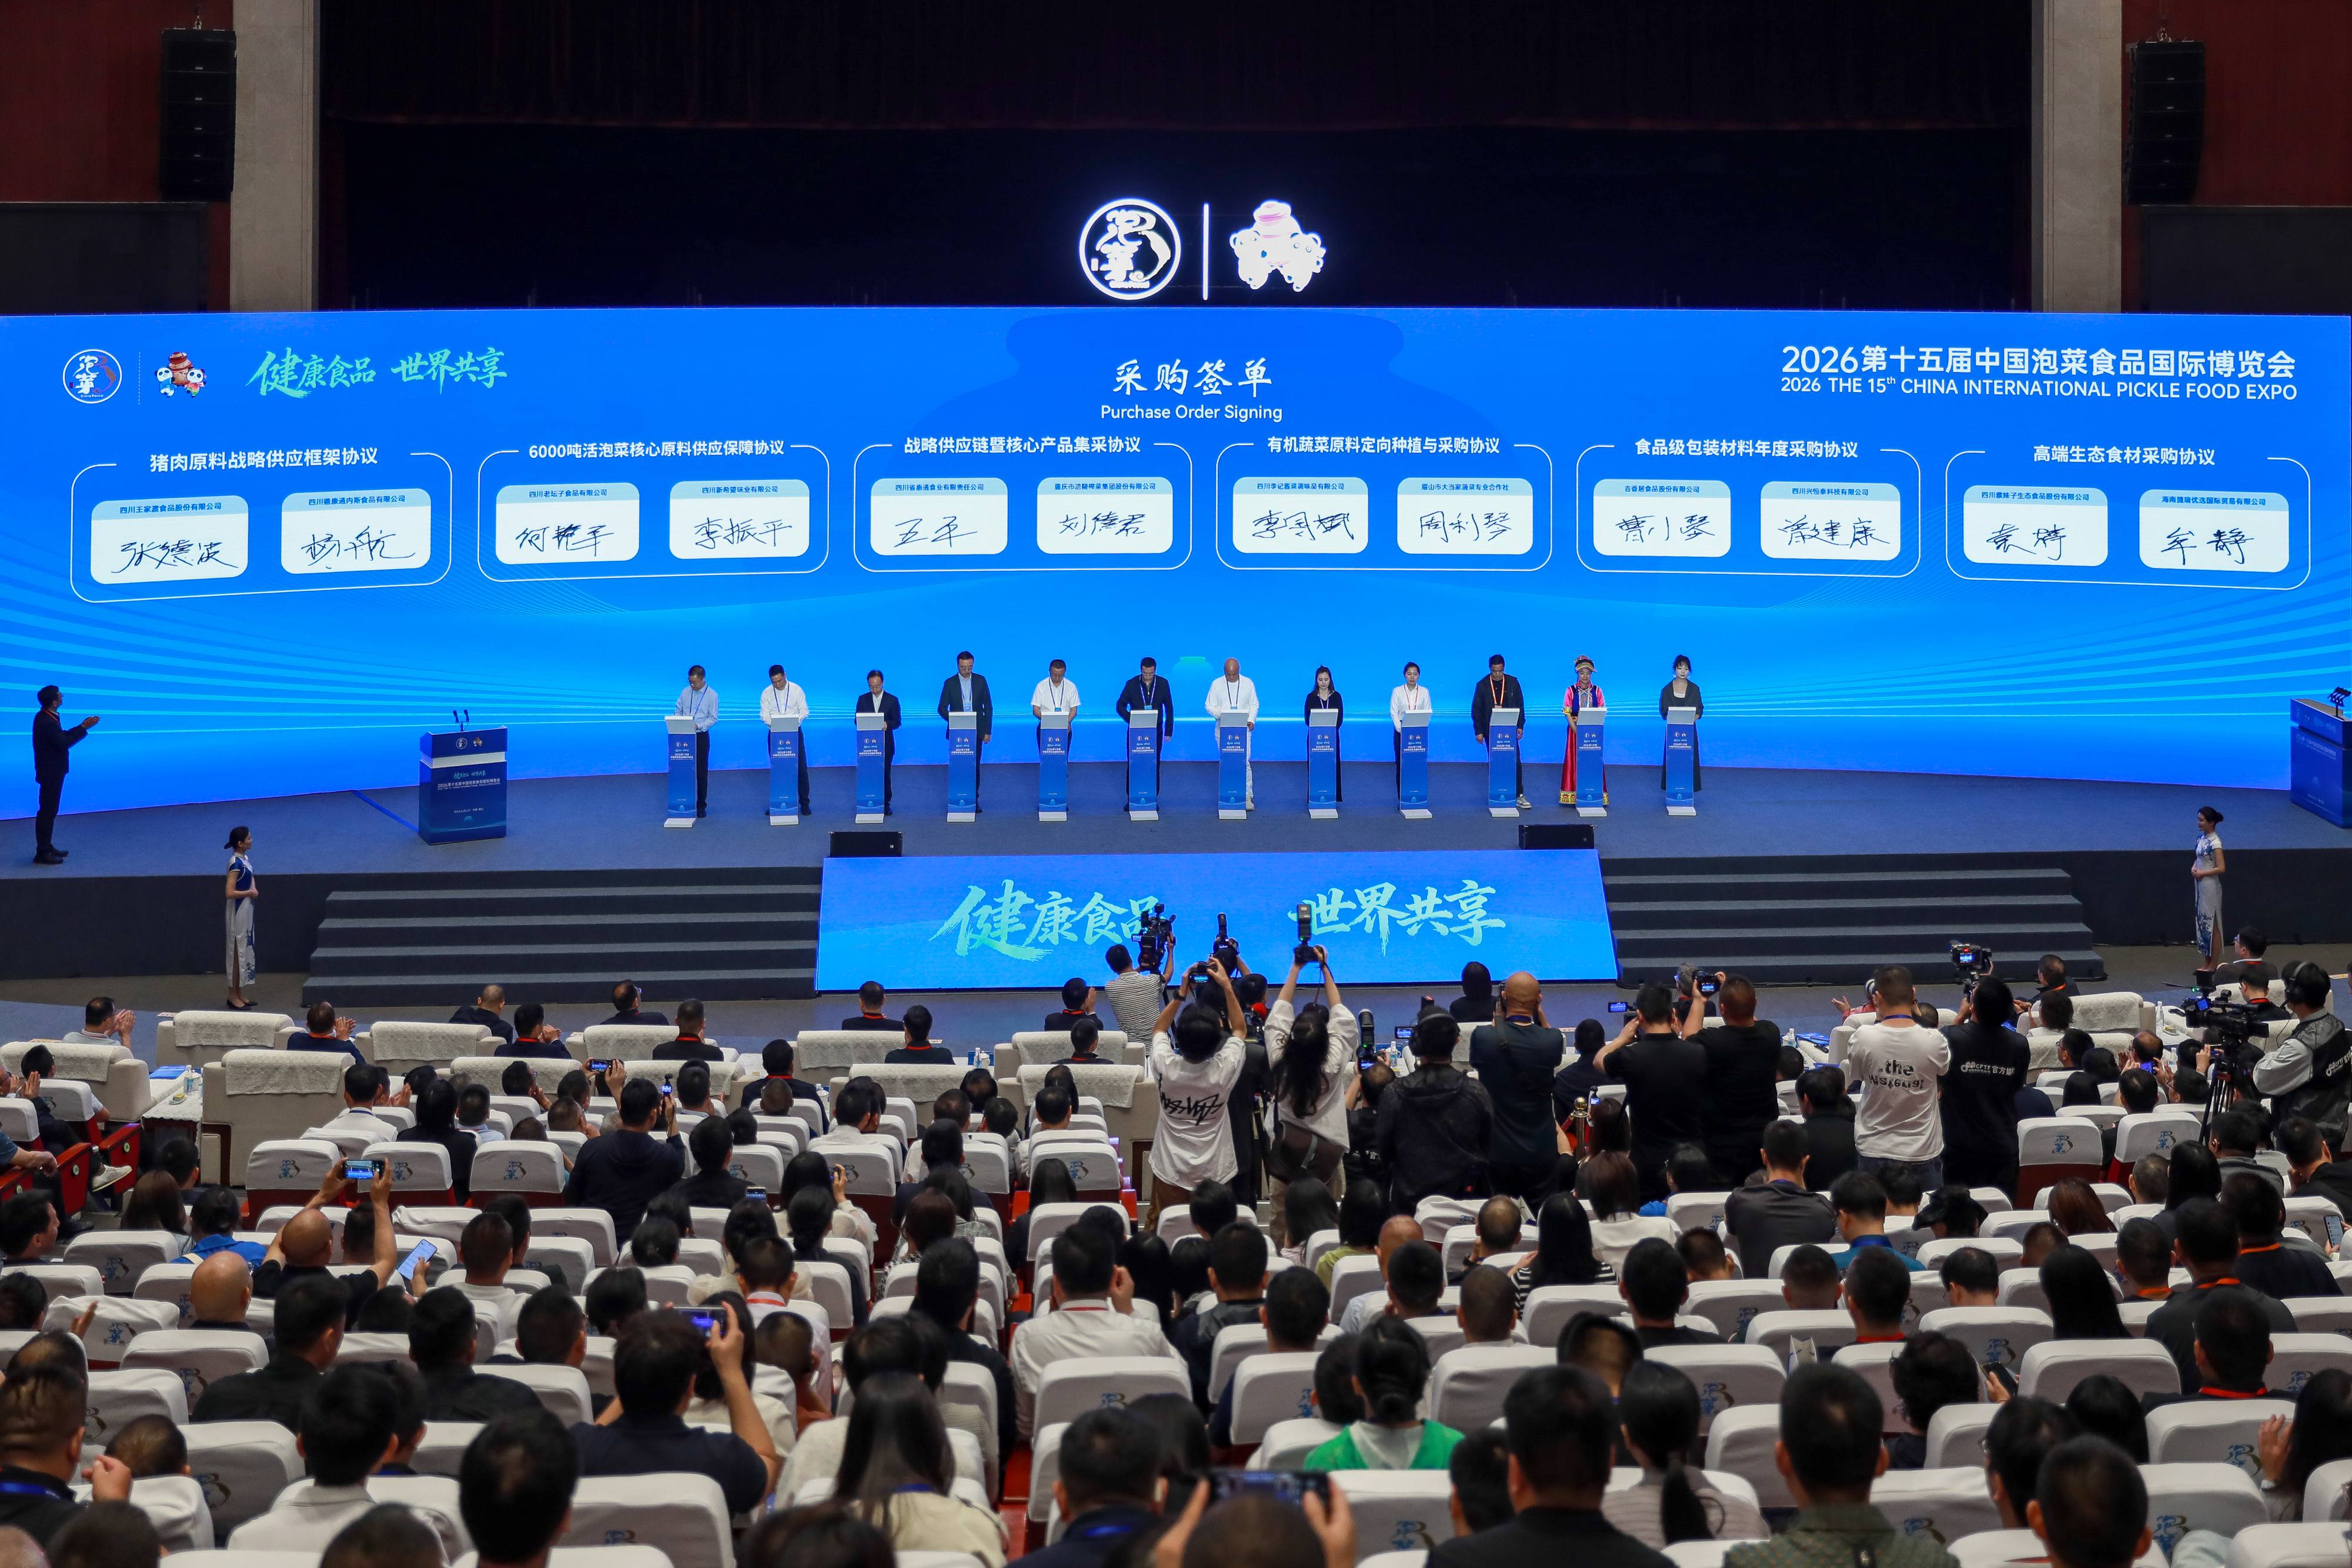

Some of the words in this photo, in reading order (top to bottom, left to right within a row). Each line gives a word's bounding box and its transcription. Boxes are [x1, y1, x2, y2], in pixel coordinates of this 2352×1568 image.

[1782, 345, 2296, 378] 2026第十五届中国泡菜食品国际博览会
[245, 347, 376, 399] 健康食品
[391, 347, 508, 395] 世界共享
[1112, 357, 1272, 398] 采购签单
[1781, 377, 1821, 392] 2026
[1828, 377, 1862, 393] THE
[1867, 376, 1896, 393] 15th
[1901, 378, 1959, 394] CHINA
[1964, 379, 2111, 397] INTERNATIONAL
[2117, 382, 2180, 398] PICKLE
[2186, 383, 2240, 399] FOOD
[2246, 384, 2297, 400] EXPO
[1101, 404, 1171, 419] Purchase
[1175, 404, 1221, 419] Order
[1224, 404, 1282, 423] Signing
[529, 440, 784, 459] 6000吨活泡菜核心原料供应保障协议
[904, 436, 1141, 454] 战略供应链暨核心产品集采协议
[1267, 436, 1500, 454] 有机蔬菜原料定向种植与采购协议
[1635, 438, 1859, 458] 食品级包装材料年度采购协议
[150, 447, 378, 472] 猪肉原料战略供应框架协议
[2033, 444, 2216, 466] 高端生态食材采购协议
[529, 489, 607, 498] 四川老坛子食品有限公司
[701, 486, 779, 494] 四川新希望味业有限公司
[1624, 485, 1700, 493] 吉香居食品股份有限公司
[119, 502, 222, 514] 四川王家渡食品股份有限公司
[1287, 879, 1506, 957] 世界共享
